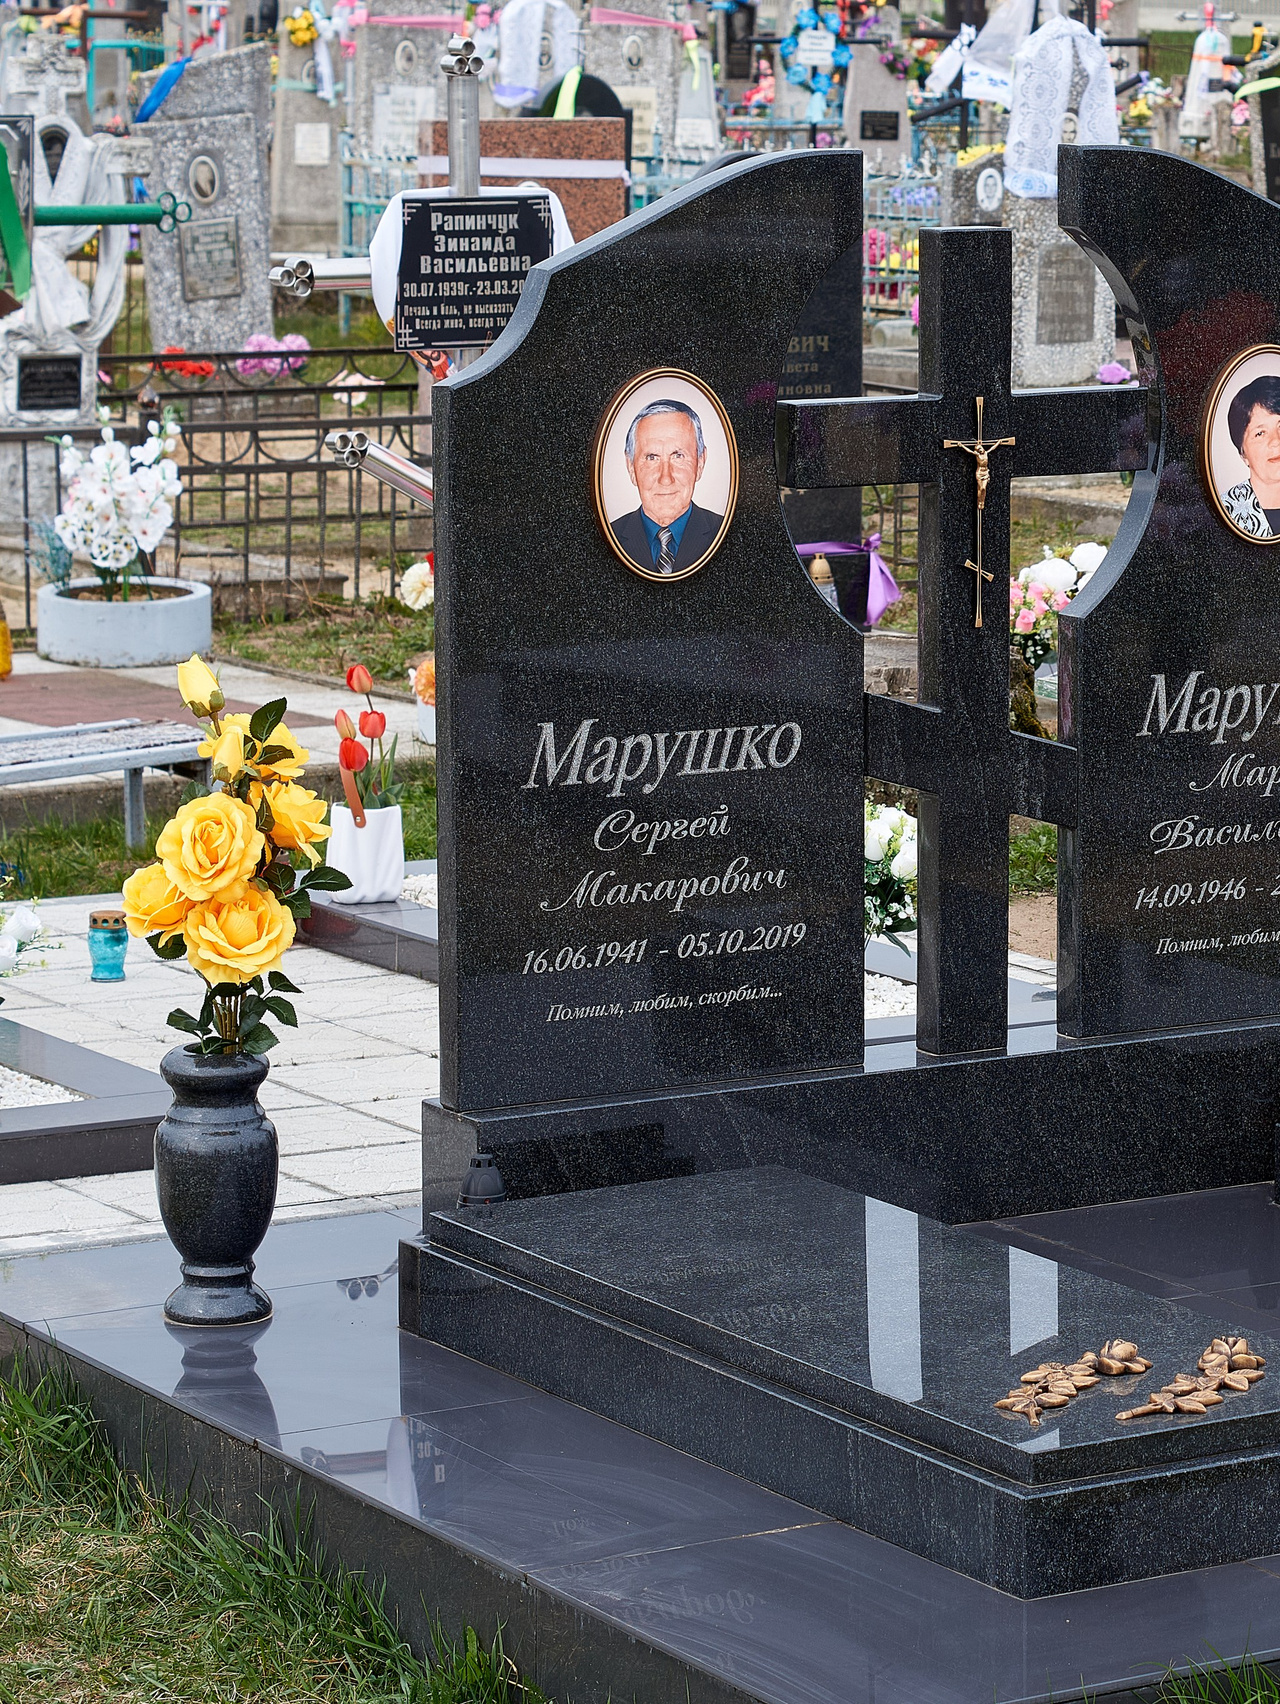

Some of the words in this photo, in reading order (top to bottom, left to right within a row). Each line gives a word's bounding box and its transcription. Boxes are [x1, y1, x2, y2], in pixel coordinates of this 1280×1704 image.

[430, 212, 520, 234] Рапинчук
[433, 234, 516, 253] Зинаида
[419, 255, 532, 275] Васильевна
[402, 279, 525, 298] 30.07.1939г.-23.03.20
[403, 304, 430, 317] Печаль
[432, 304, 438, 316] и
[440, 303, 460, 316] боль,
[463, 303, 473, 315] не
[475, 303, 515, 315] высказать
[415, 318, 441, 331] Всегда
[443, 318, 466, 330] жива,
[468, 317, 495, 329] всегда
[496, 316, 507, 327] ты
[787, 335, 830, 353] ВИЧ
[520, 718, 802, 798] Марушко
[592, 803, 732, 856] Сергей
[539, 855, 788, 913] Макарович
[1134, 876, 1247, 911] 14.09.1946
[521, 937, 649, 976] 16.06.1941
[676, 922, 807, 959] 05.10.2019
[1155, 936, 1225, 956] Помним,
[545, 1003, 625, 1023] Помним,
[627, 993, 694, 1015] любим,
[698, 982, 783, 1007] скорбим...
